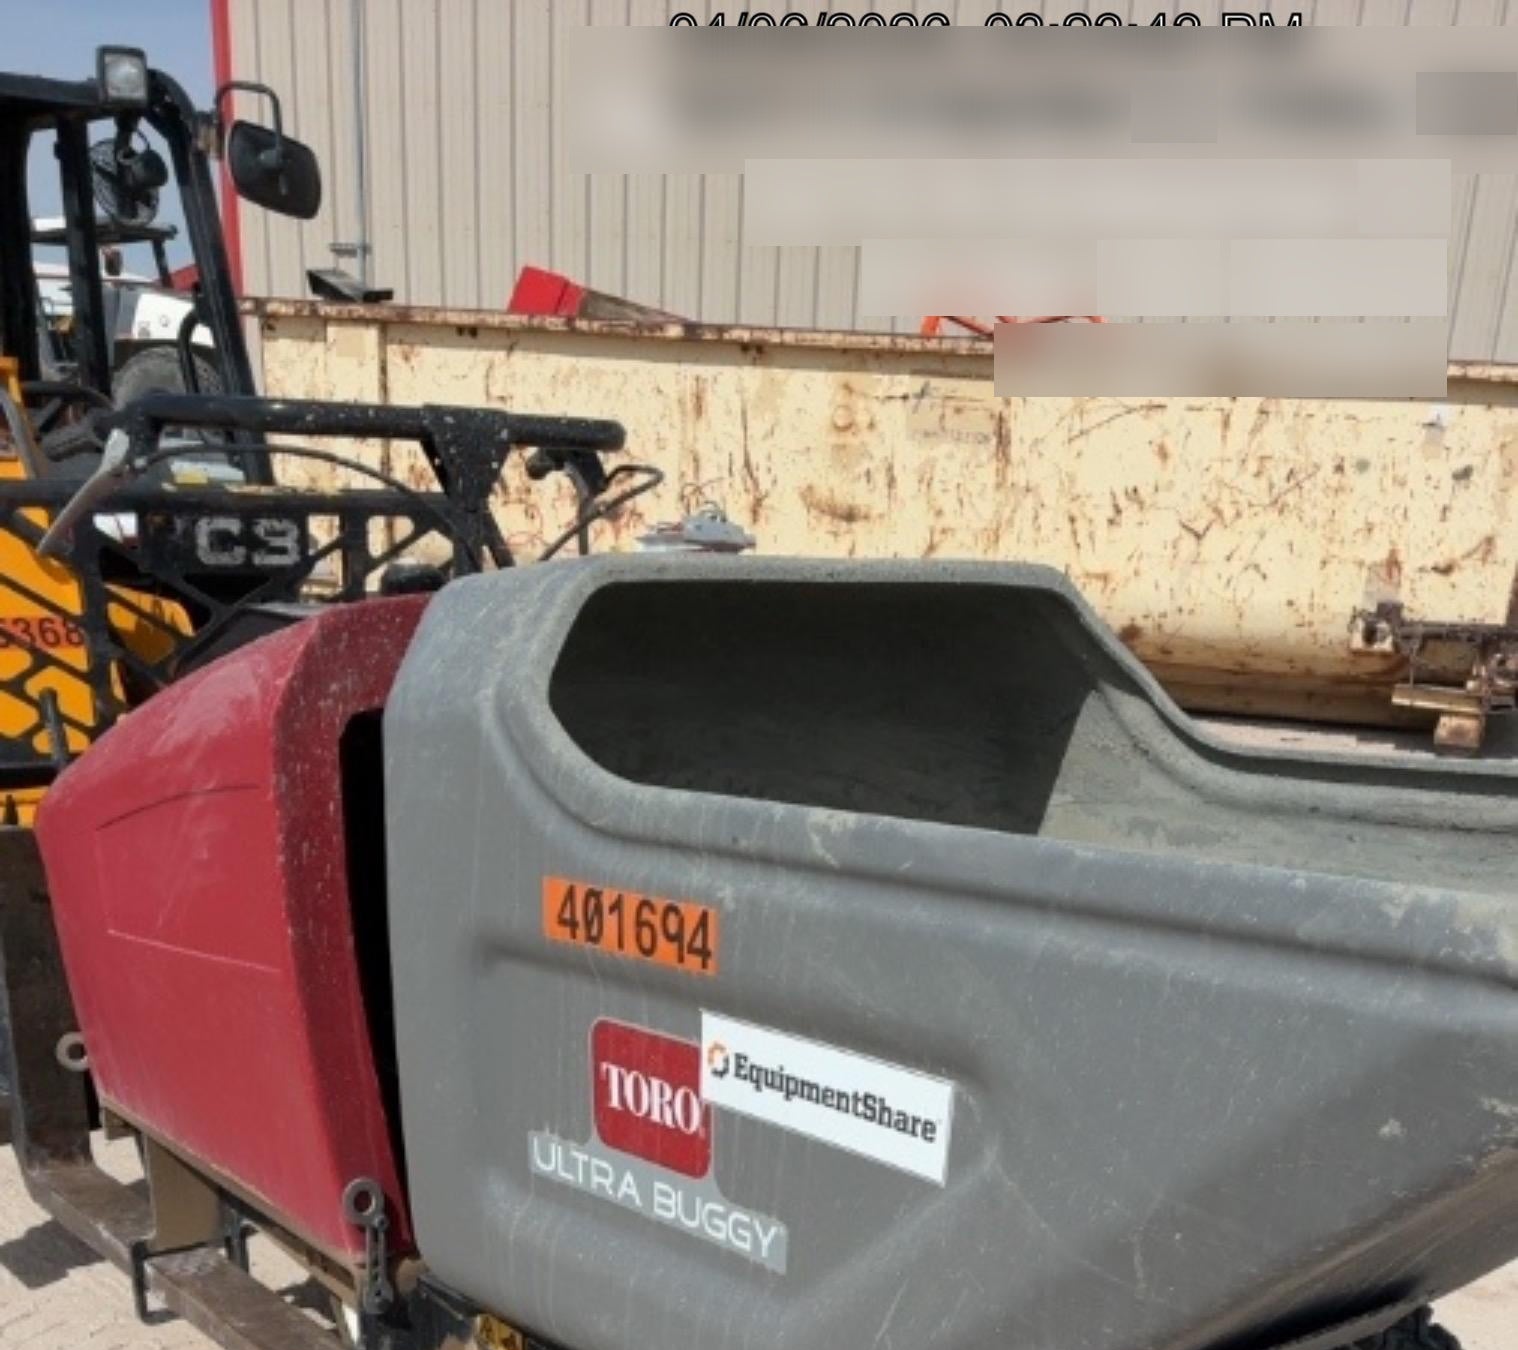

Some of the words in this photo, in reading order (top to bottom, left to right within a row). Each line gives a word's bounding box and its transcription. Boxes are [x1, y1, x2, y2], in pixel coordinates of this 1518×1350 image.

[557, 883, 712, 970] 401694
[601, 1061, 701, 1135] TORO
[734, 1052, 937, 1144] EquipmentShare
[533, 1135, 643, 1208] ULTRA
[653, 1181, 778, 1258] BUGGY
